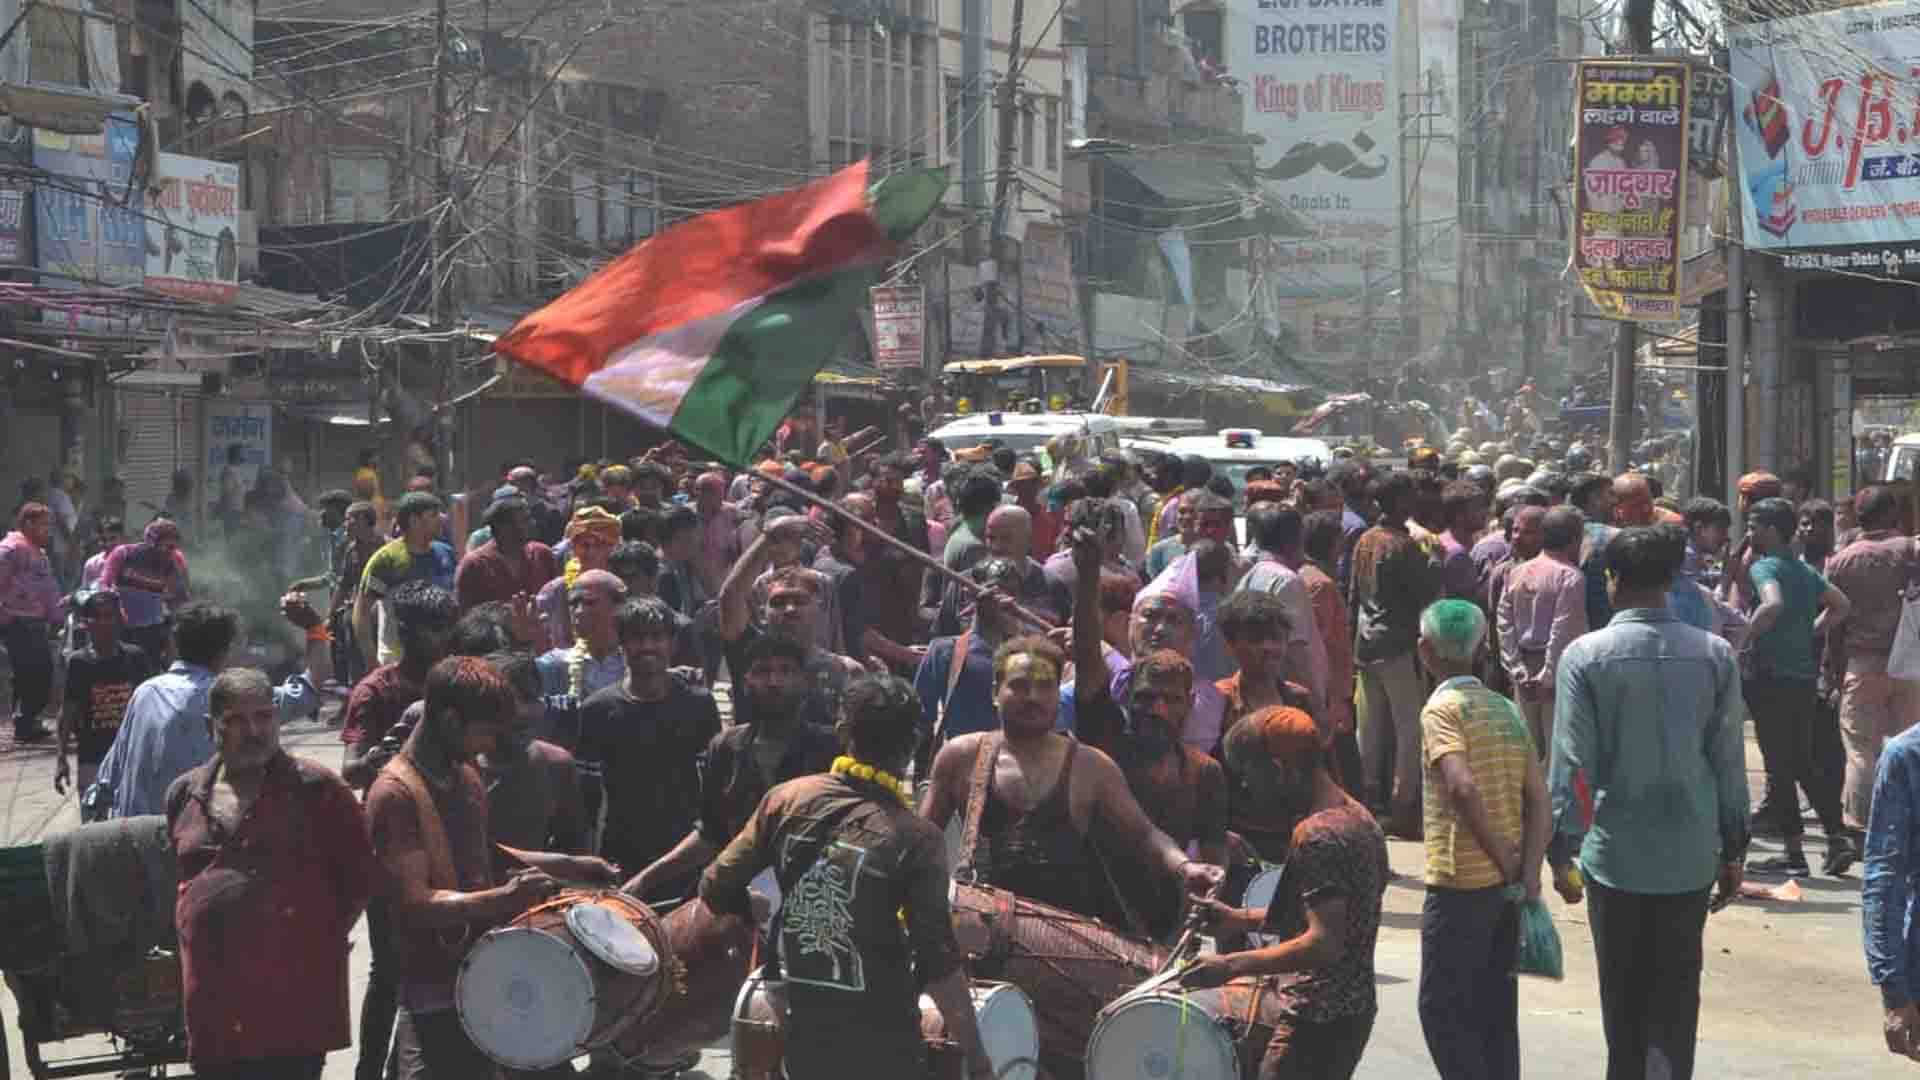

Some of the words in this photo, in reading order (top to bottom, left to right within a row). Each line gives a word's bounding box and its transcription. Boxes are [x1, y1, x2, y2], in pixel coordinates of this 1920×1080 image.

[1256, 23, 1386, 54] BROTHERS
[1256, 73, 1297, 120] King
[1303, 73, 1325, 112] of
[1329, 72, 1385, 119] Kings
